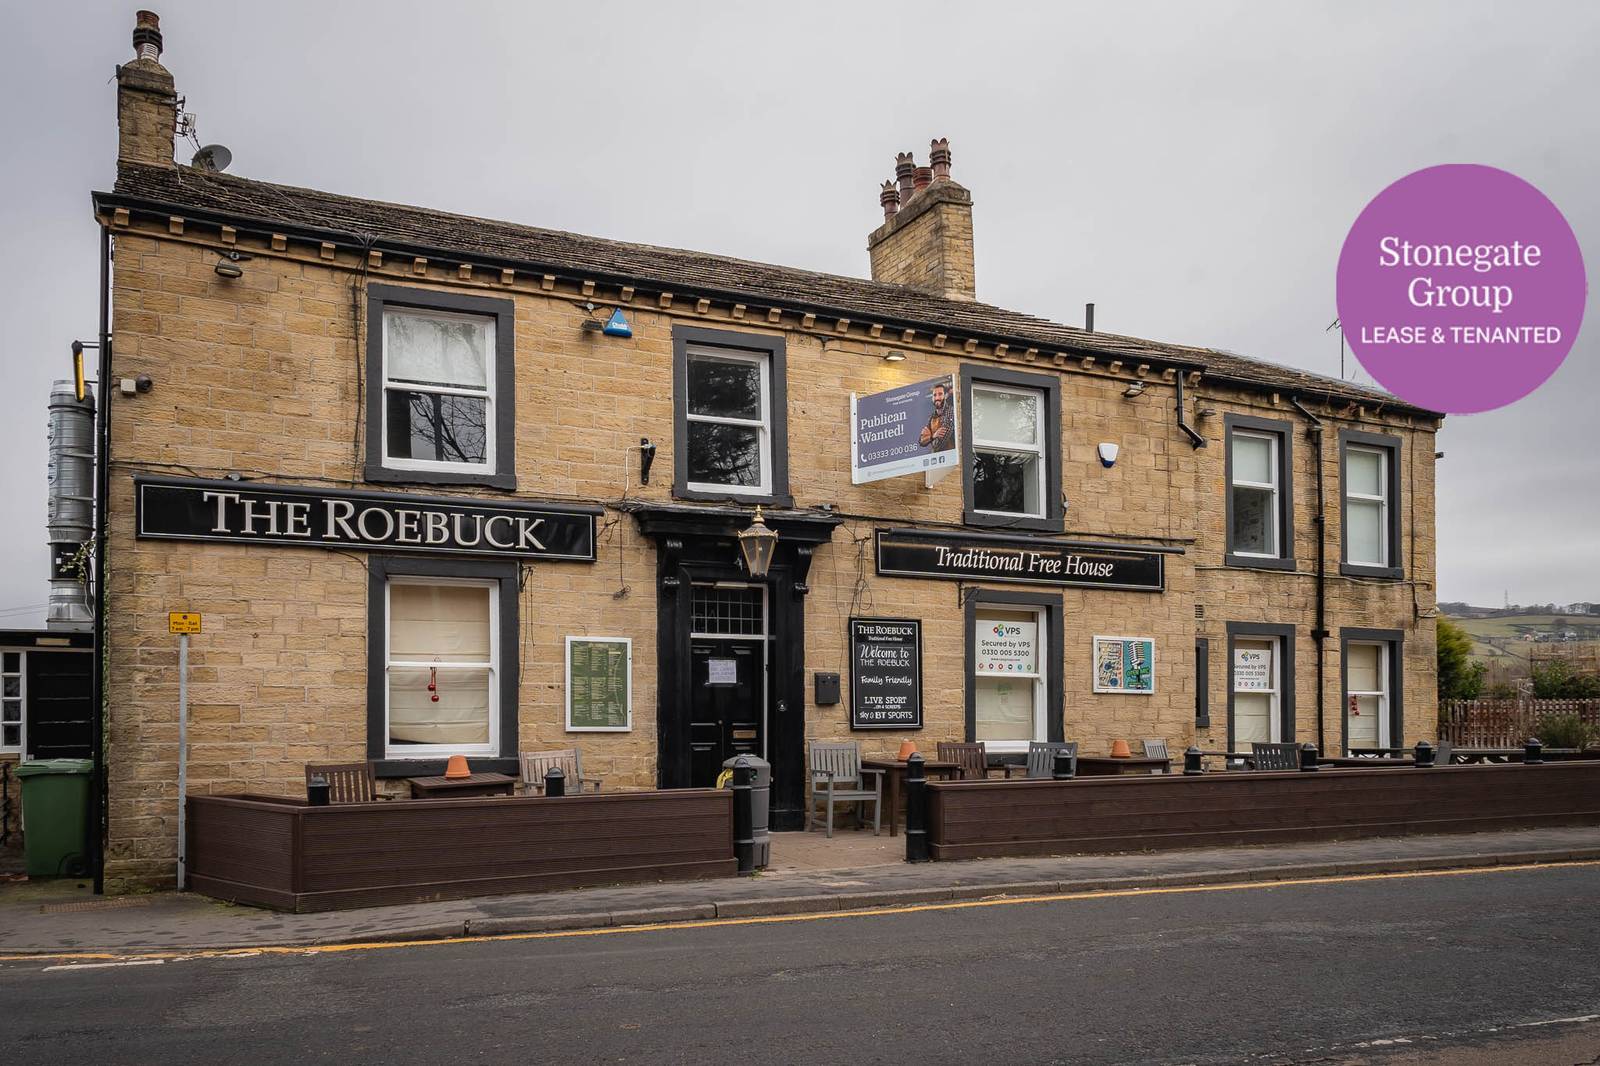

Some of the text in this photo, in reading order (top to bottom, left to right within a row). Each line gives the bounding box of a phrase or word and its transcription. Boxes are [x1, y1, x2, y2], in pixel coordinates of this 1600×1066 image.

[860, 411, 907, 430] Publican
[860, 424, 904, 444] Wanted!
[867, 443, 918, 461] 03333 200 036
[203, 491, 547, 550] THE ROEBUCK
[936, 546, 1113, 577] Traditional Free House
[857, 625, 913, 635] THE ROEBUCK
[1005, 627, 1021, 635] VPS
[860, 644, 910, 659] Welcome to
[877, 659, 910, 667] ROEBUCK
[861, 676, 912, 686] Family Friendly
[864, 696, 907, 704] LIVE SPORT
[875, 711, 887, 719] BT
[887, 711, 913, 719] SPORTS
